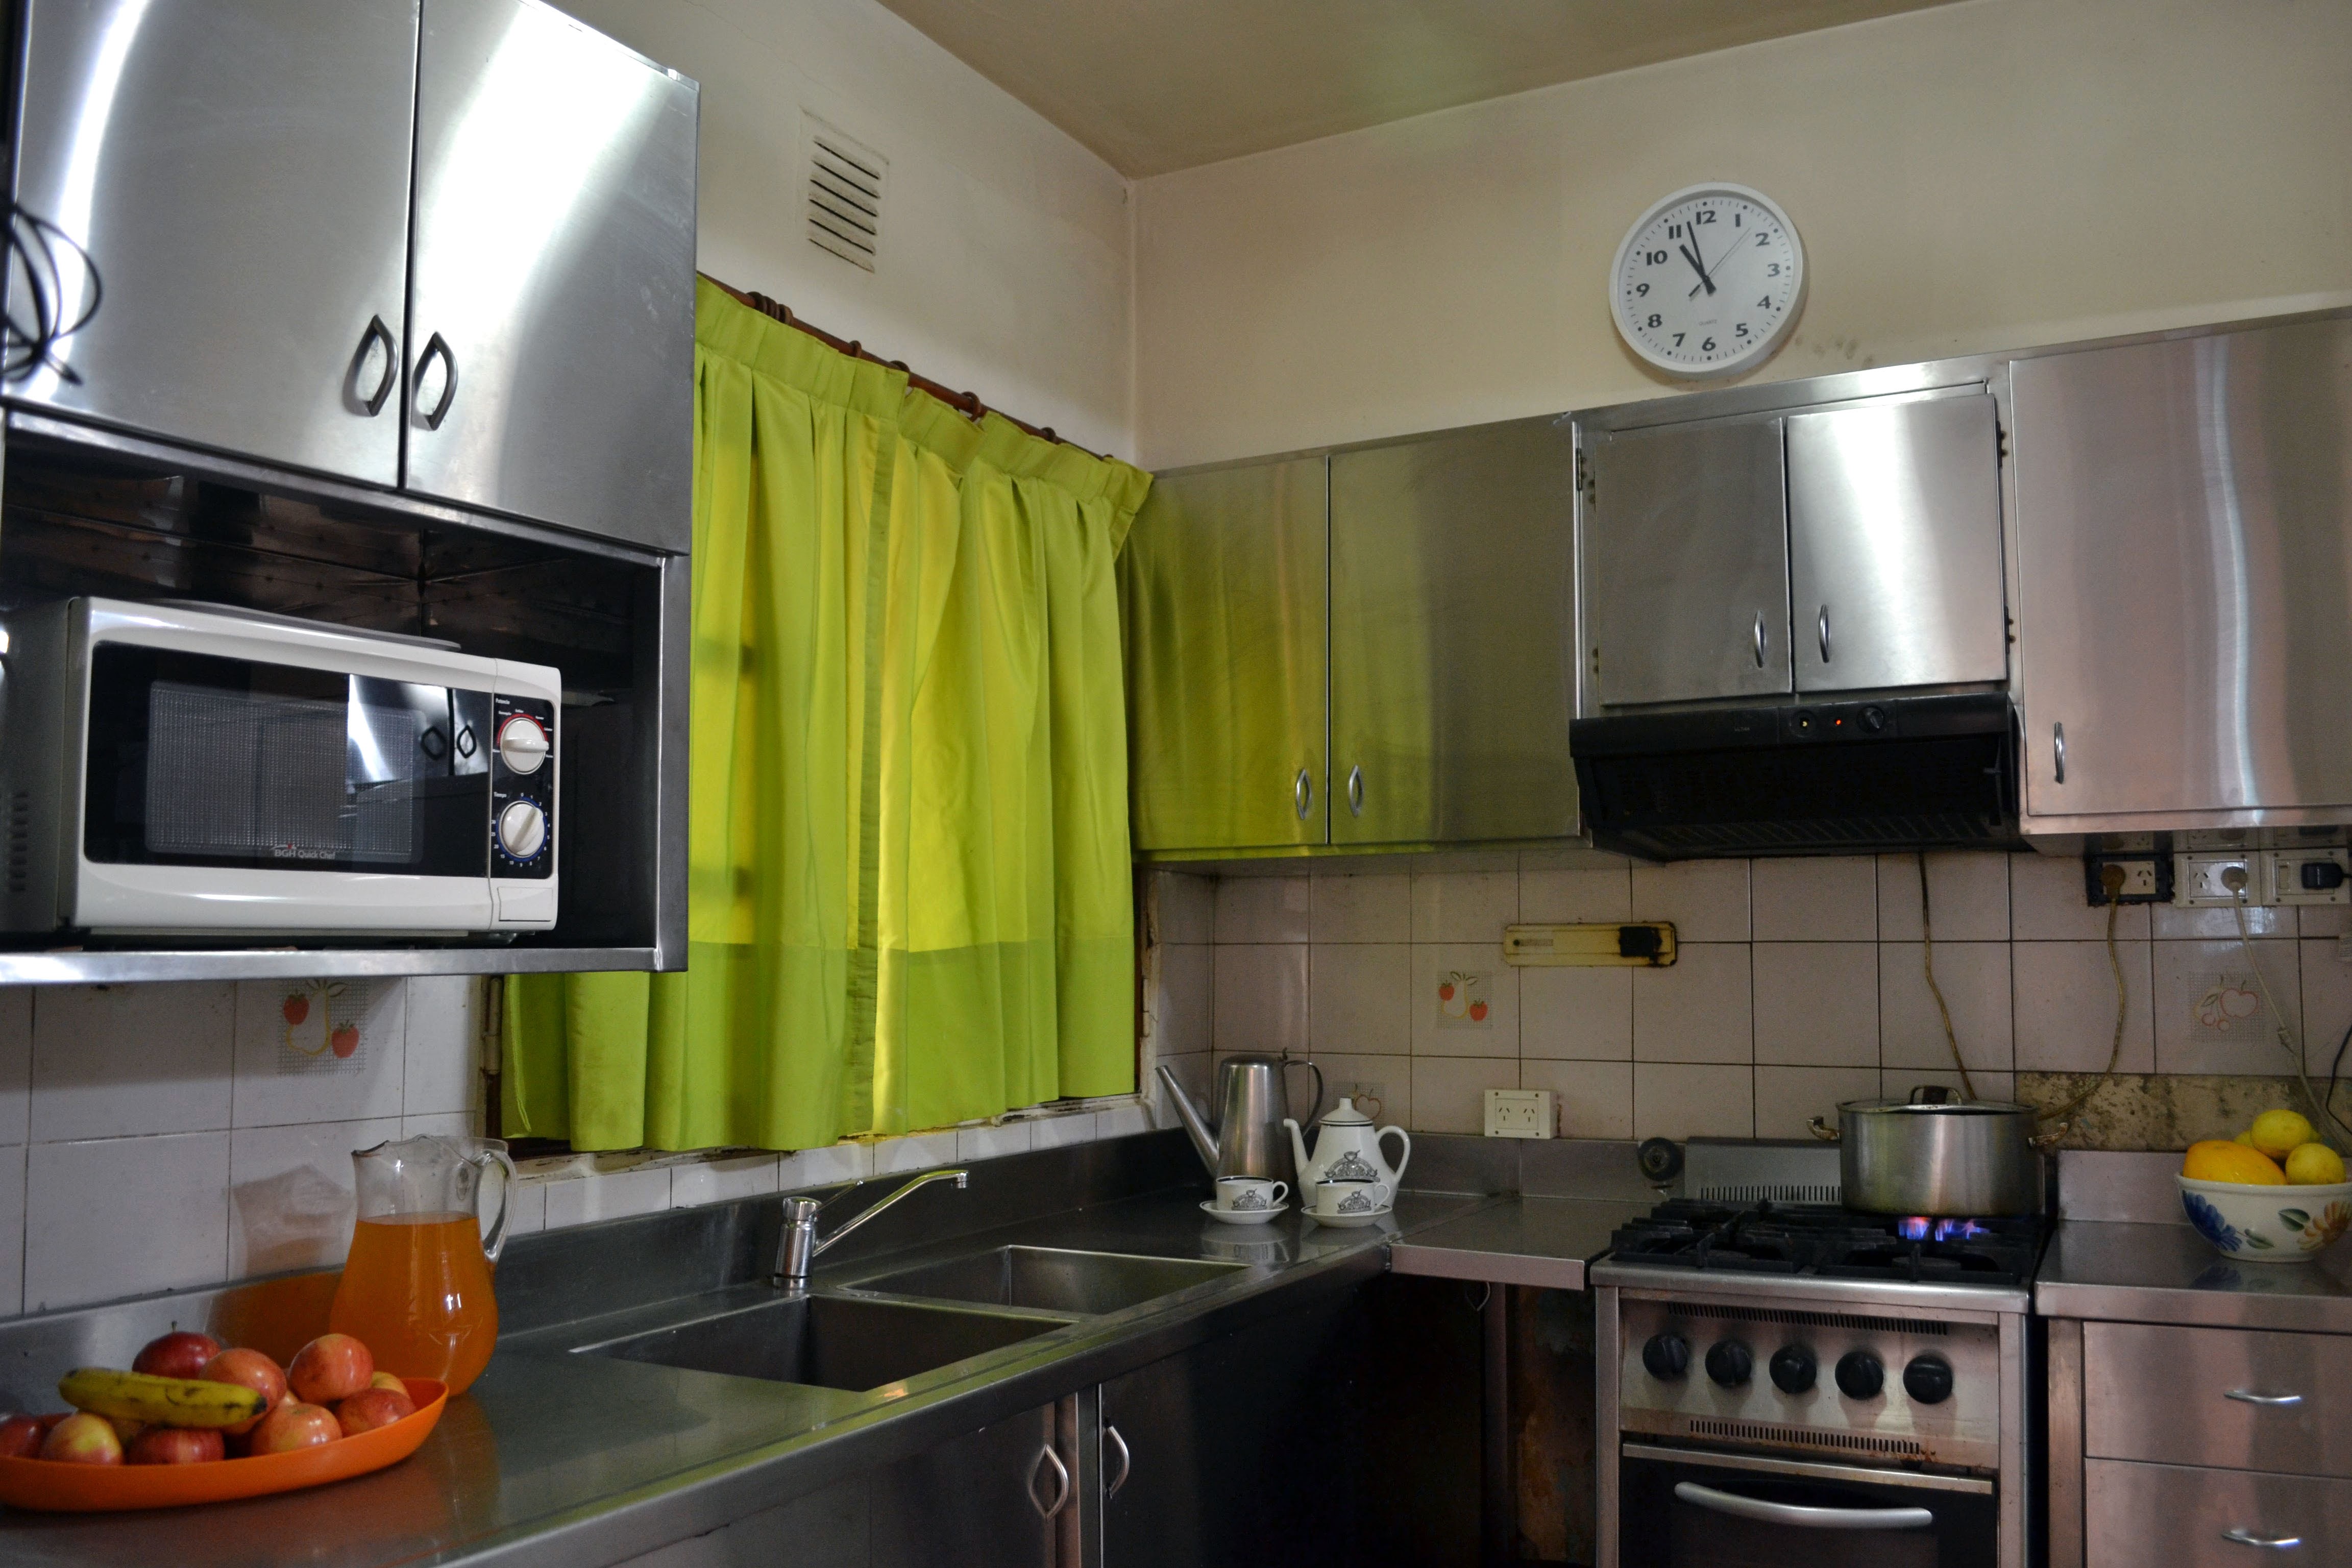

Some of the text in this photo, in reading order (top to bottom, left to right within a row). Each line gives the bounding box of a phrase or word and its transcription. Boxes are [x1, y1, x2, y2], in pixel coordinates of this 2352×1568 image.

[1696, 210, 1717, 225] 12
[1735, 213, 1741, 227] 1
[1668, 225, 1682, 239] 11
[1755, 232, 1770, 247] 2
[1646, 250, 1668, 266] 10
[1767, 263, 1780, 277] 3
[1635, 283, 1650, 297] 9
[1756, 295, 1772, 309] 4
[1647, 314, 1662, 328] 8
[1735, 323, 1749, 337] 5
[1673, 332, 1685, 347] 7
[1701, 337, 1716, 351] 6
[298, 850, 318, 859] Quick
[319, 851, 335, 860] Chef
